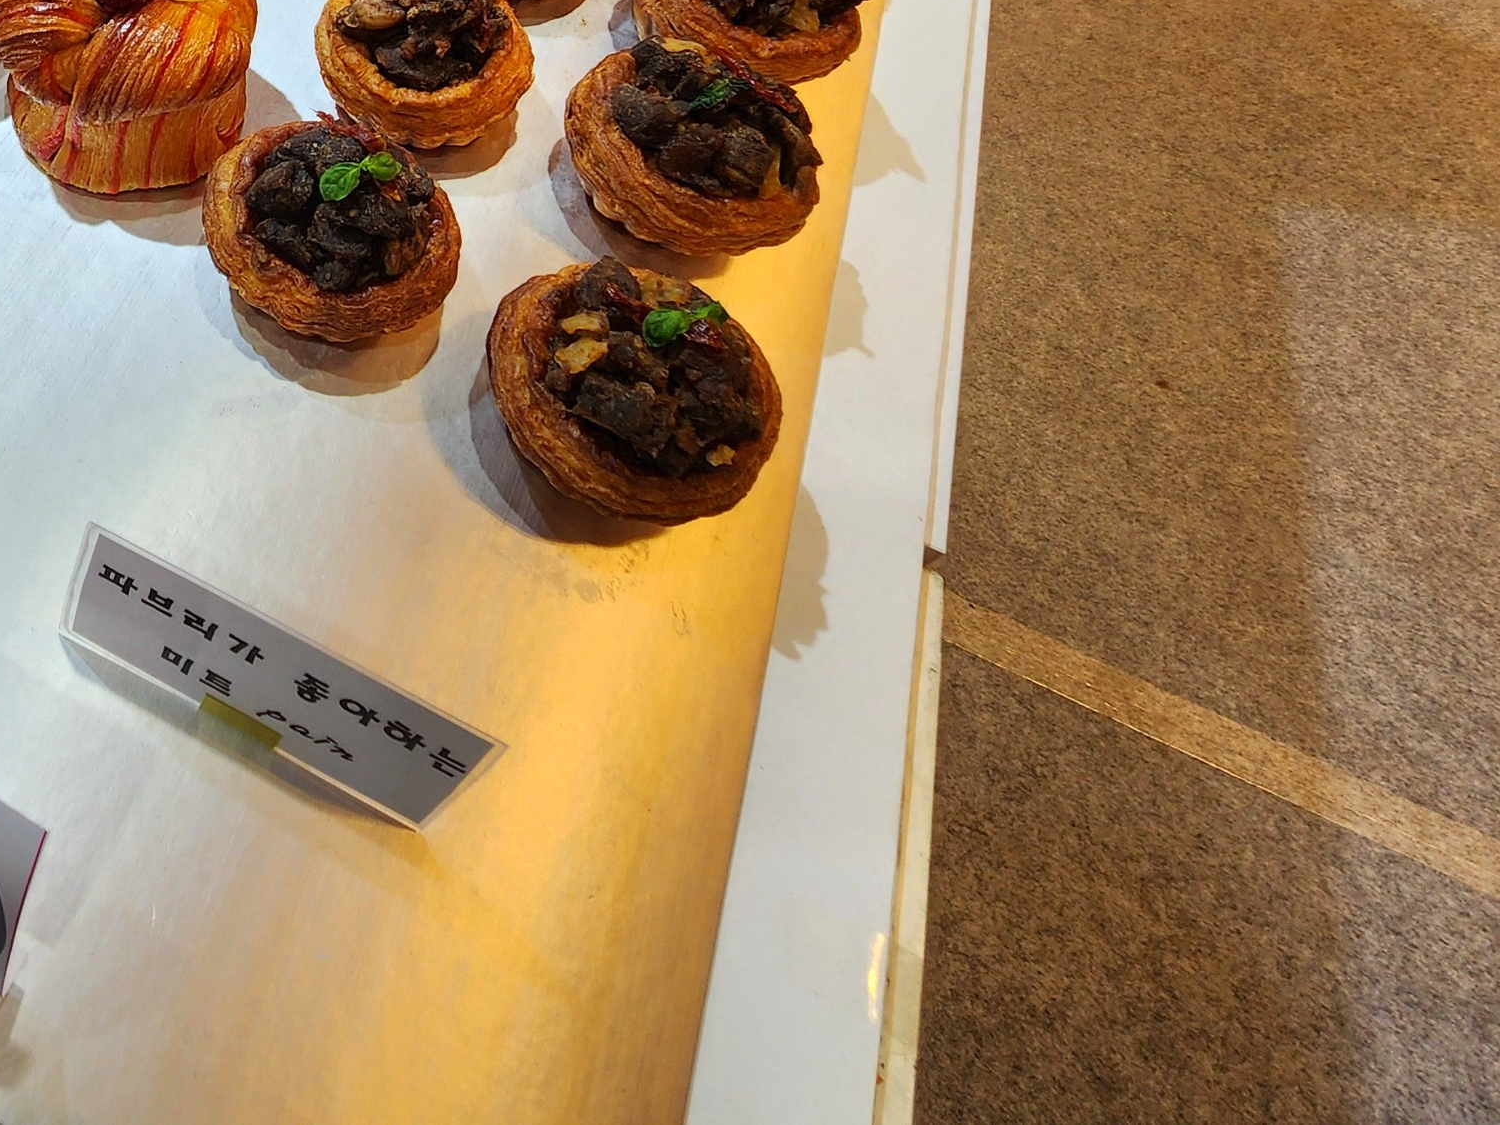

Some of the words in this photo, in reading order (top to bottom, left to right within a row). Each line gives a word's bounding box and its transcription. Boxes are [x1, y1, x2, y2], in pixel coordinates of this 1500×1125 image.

[98, 563, 265, 665] 파브리가
[293, 672, 467, 777] 좋아하는
[161, 645, 234, 697] 미트
[255, 704, 355, 763] pain
